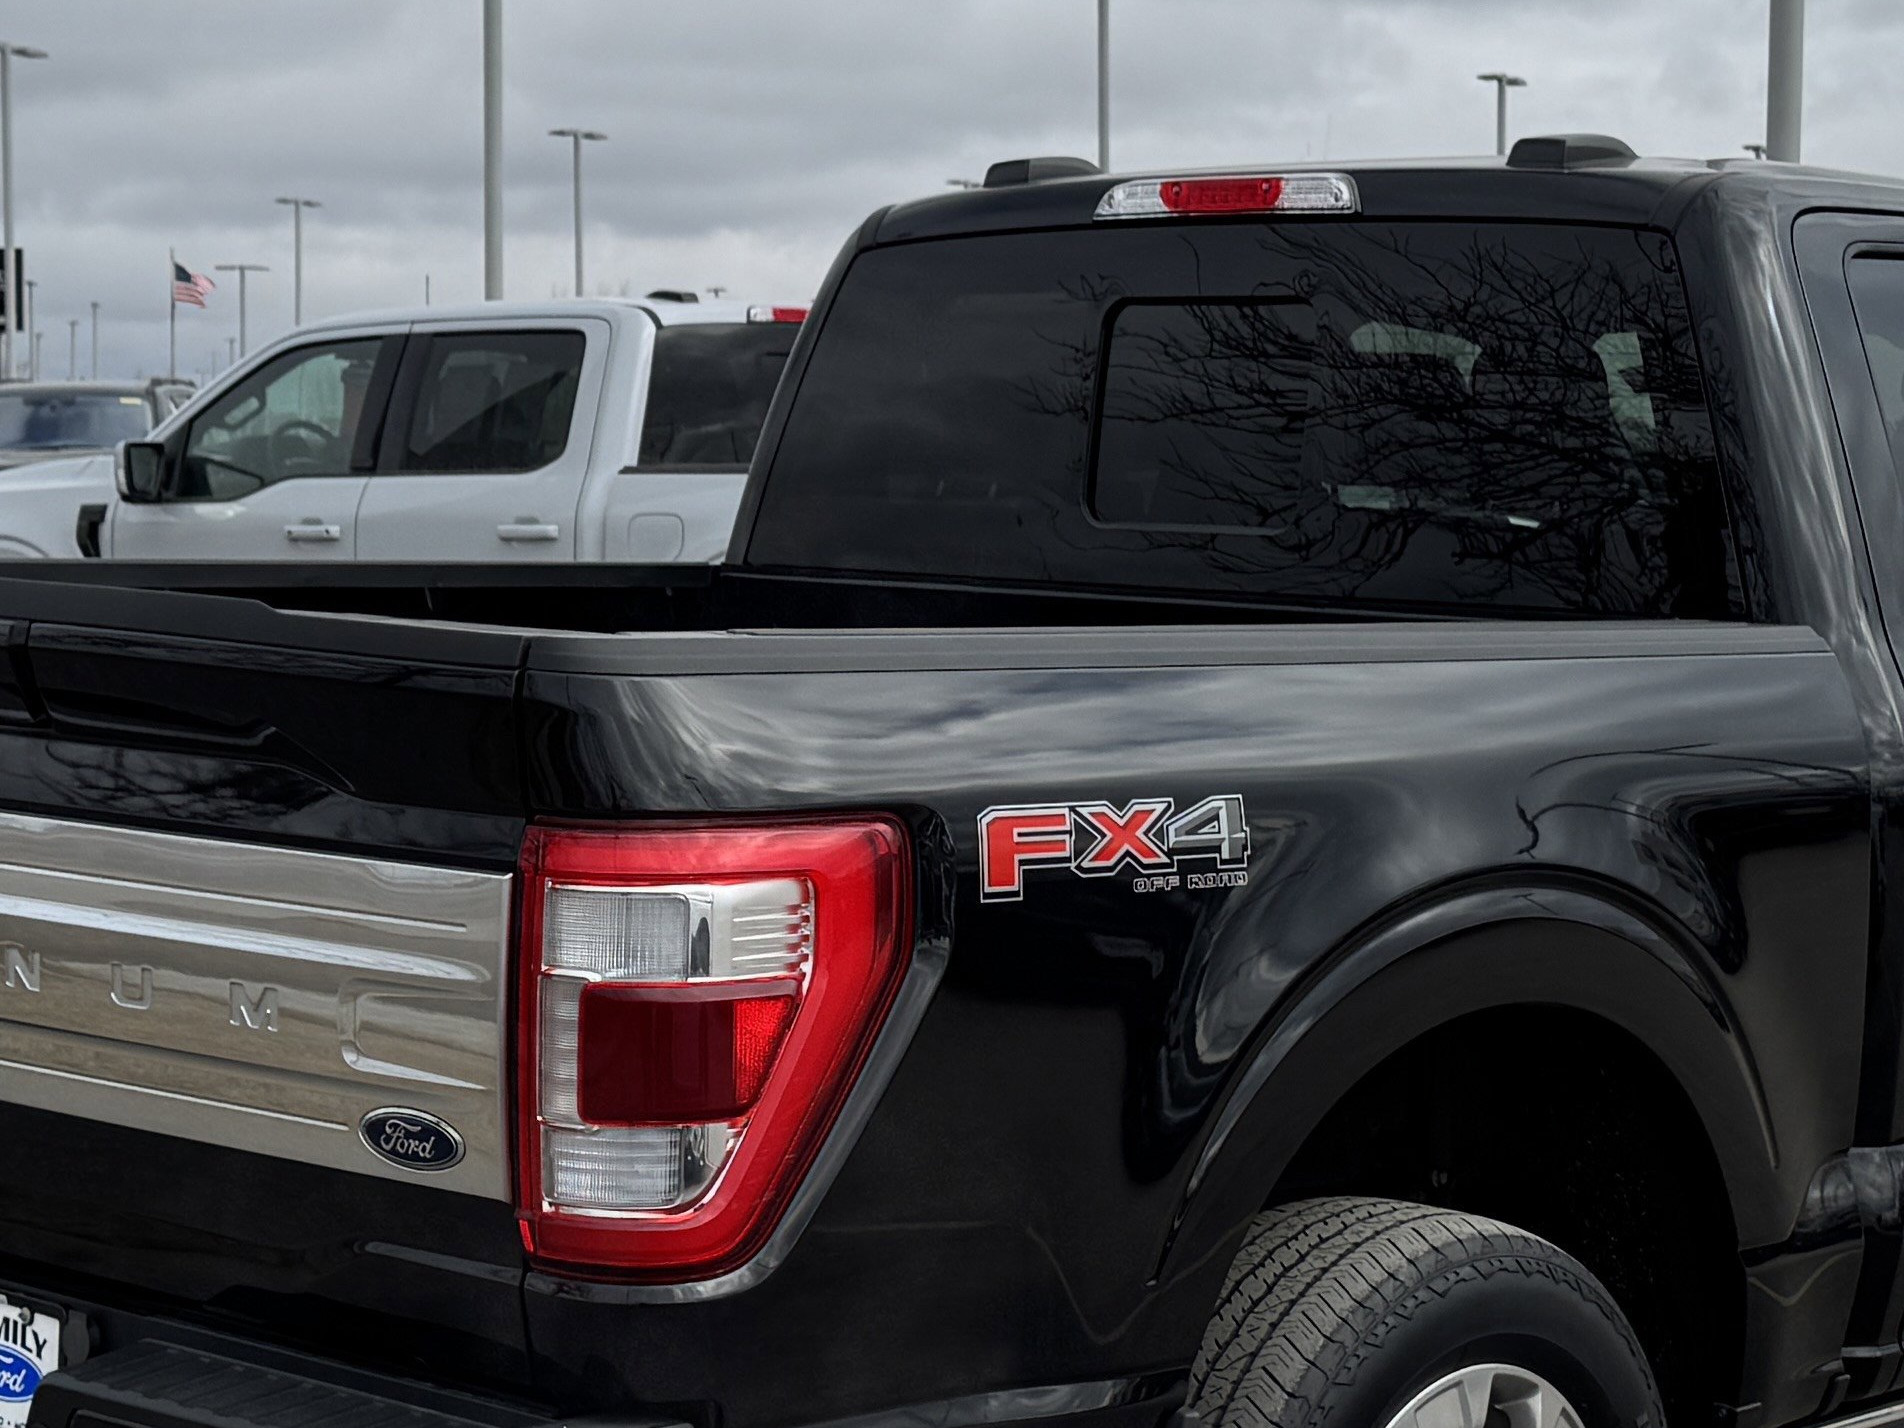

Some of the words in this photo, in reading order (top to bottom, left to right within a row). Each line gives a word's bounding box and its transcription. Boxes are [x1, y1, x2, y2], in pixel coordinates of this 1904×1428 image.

[977, 794, 1251, 903] FX4
[1133, 874, 1180, 893] OFF
[1187, 871, 1249, 890] ROAD
[380, 1118, 436, 1159] Ford
